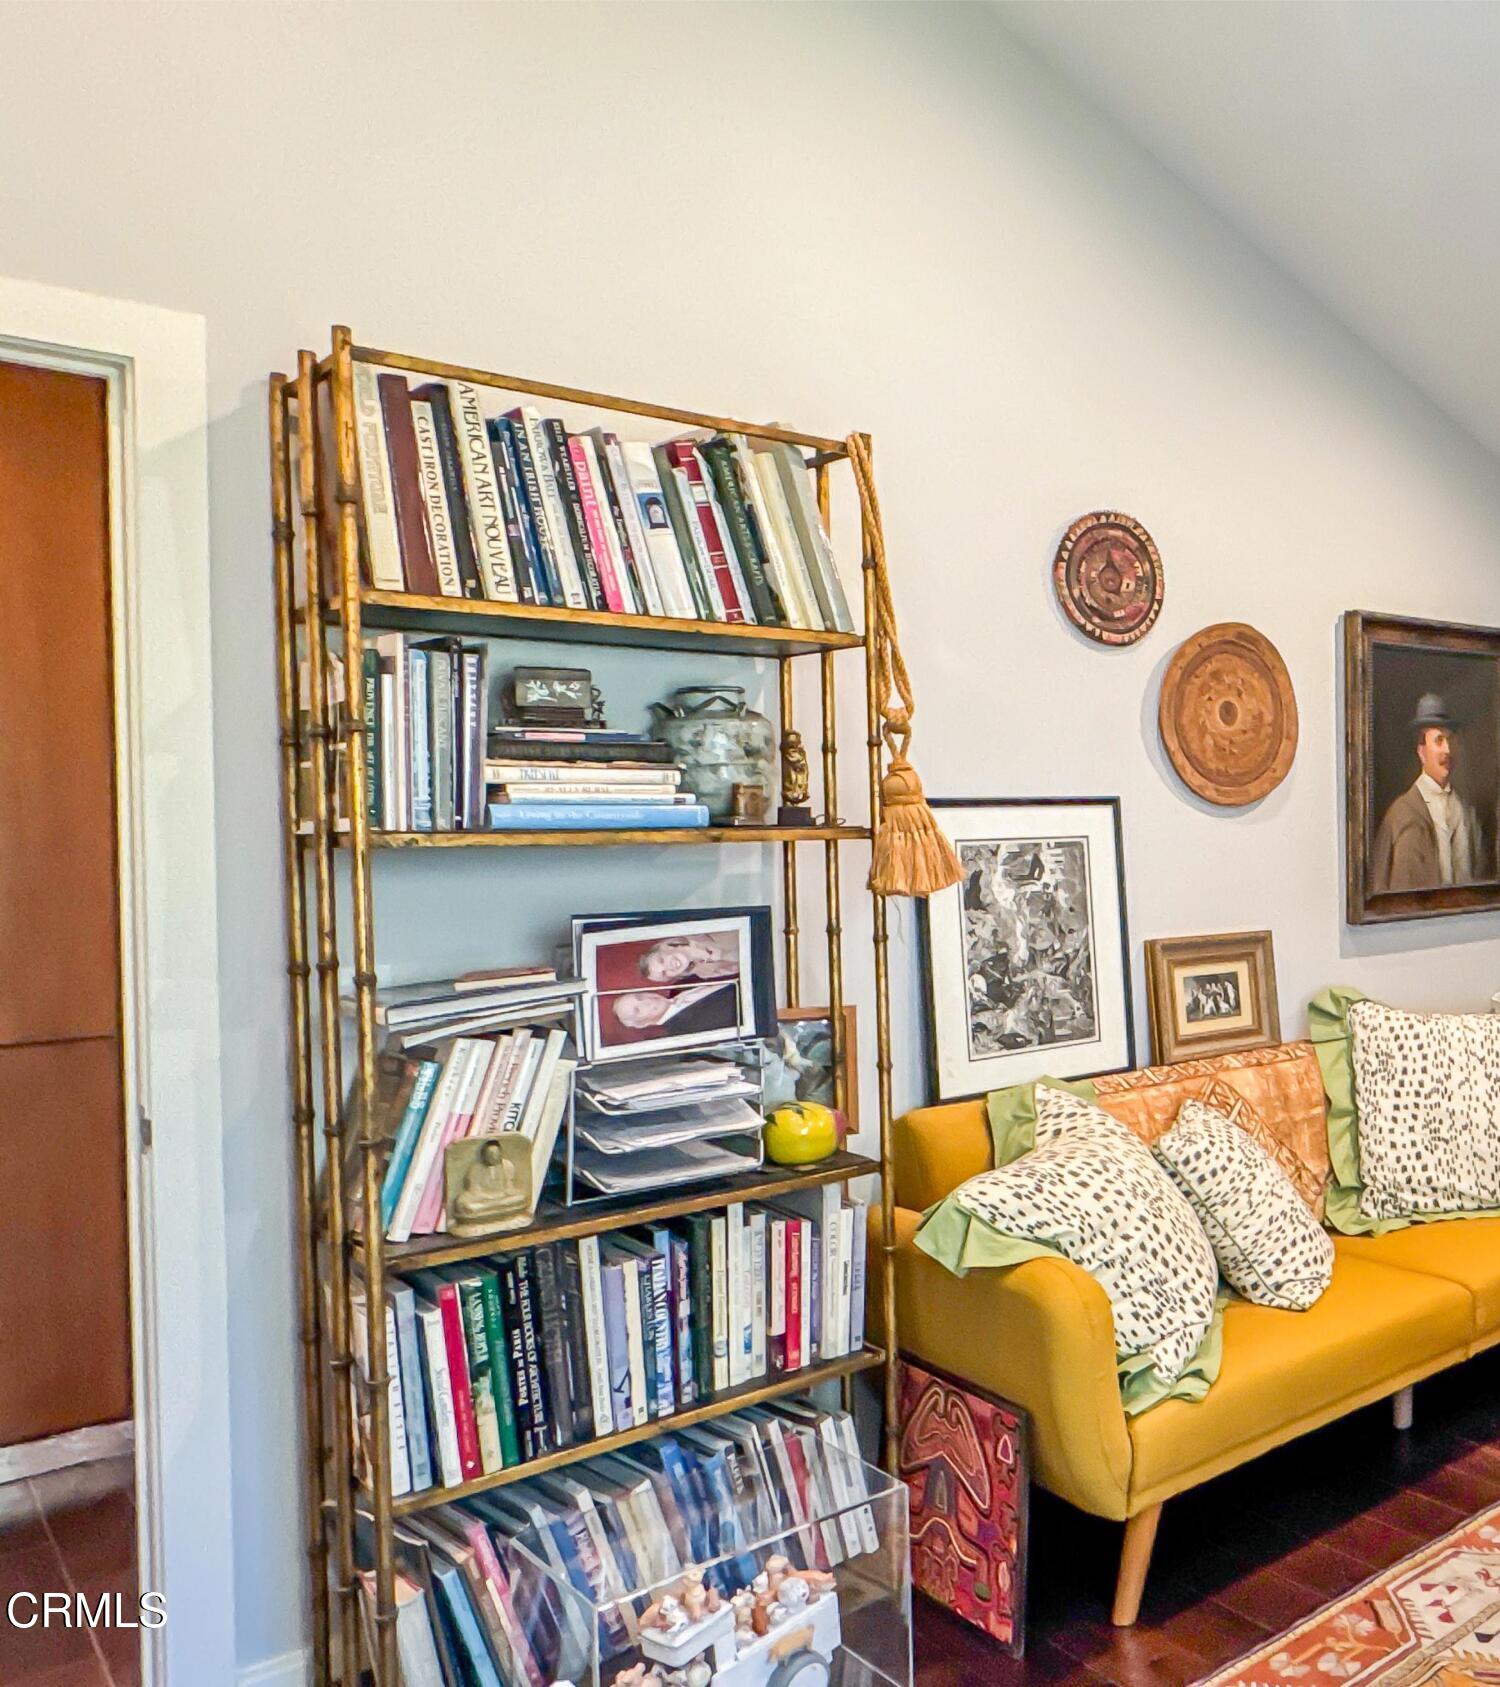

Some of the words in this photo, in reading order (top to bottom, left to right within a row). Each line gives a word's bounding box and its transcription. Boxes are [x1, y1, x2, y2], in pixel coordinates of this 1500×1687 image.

[416, 415, 433, 452] CAST
[457, 379, 488, 476] AMERICAN
[513, 420, 526, 439] IN
[517, 439, 531, 463] AN
[422, 453, 438, 490] IRON
[572, 458, 596, 507] paint
[475, 475, 497, 515] ART
[429, 493, 455, 587] DECORATION
[482, 512, 511, 595] NOUVEAU
[518, 1279, 529, 1298] THE
[520, 1298, 530, 1321] FOUR
[526, 1350, 536, 1362] OF
[528, 1362, 543, 1423] ARCHITECTURE
